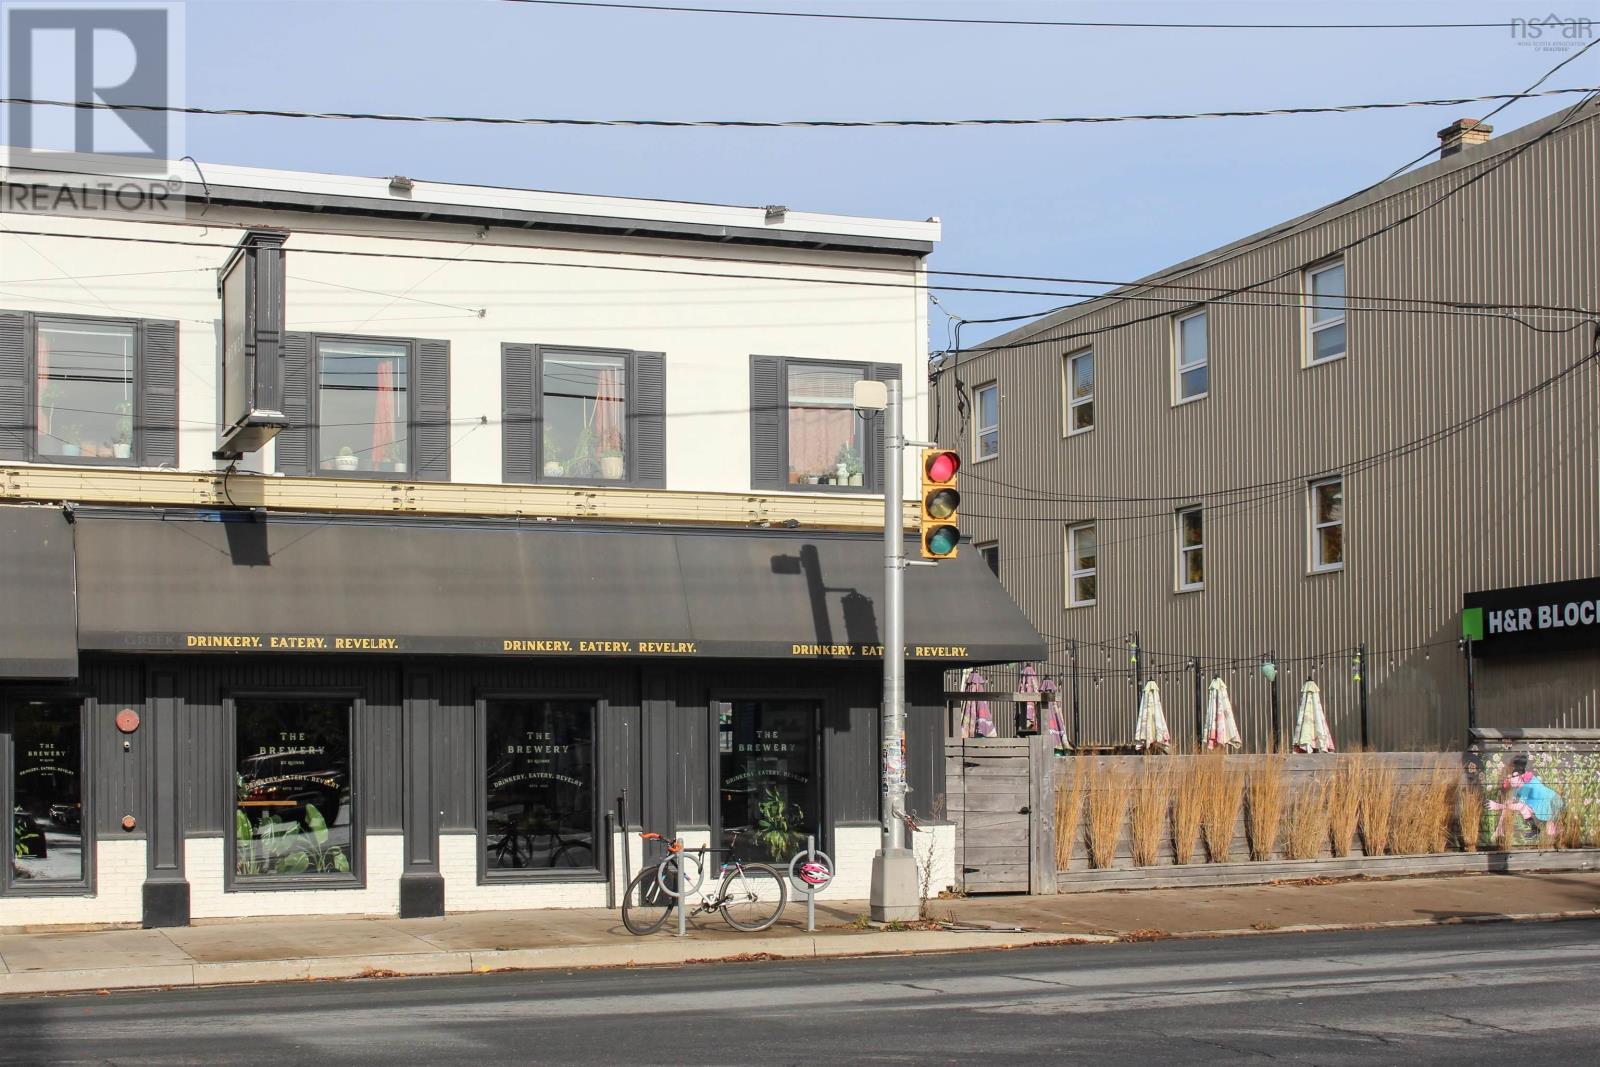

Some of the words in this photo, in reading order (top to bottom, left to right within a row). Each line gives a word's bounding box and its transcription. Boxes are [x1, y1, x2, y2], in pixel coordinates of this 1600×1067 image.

[1489, 607, 1533, 634] H&R
[1538, 600, 1600, 628] BLOC
[187, 635, 263, 647] DRINKERY.
[270, 636, 327, 648] EATERY.
[335, 637, 399, 649] REVELRY.
[503, 640, 573, 651] DRINKERY.
[579, 641, 632, 652] EATERY.
[639, 642, 697, 653] REVELRY.
[792, 644, 855, 655] DRINKERY.
[915, 646, 969, 657] REVELRY.
[280, 732, 305, 741] THE
[527, 731, 551, 740] THE
[756, 730, 778, 739] THE
[260, 746, 325, 755] BREWERY
[508, 745, 569, 754] BREWERY
[739, 743, 796, 752] BREWERY
